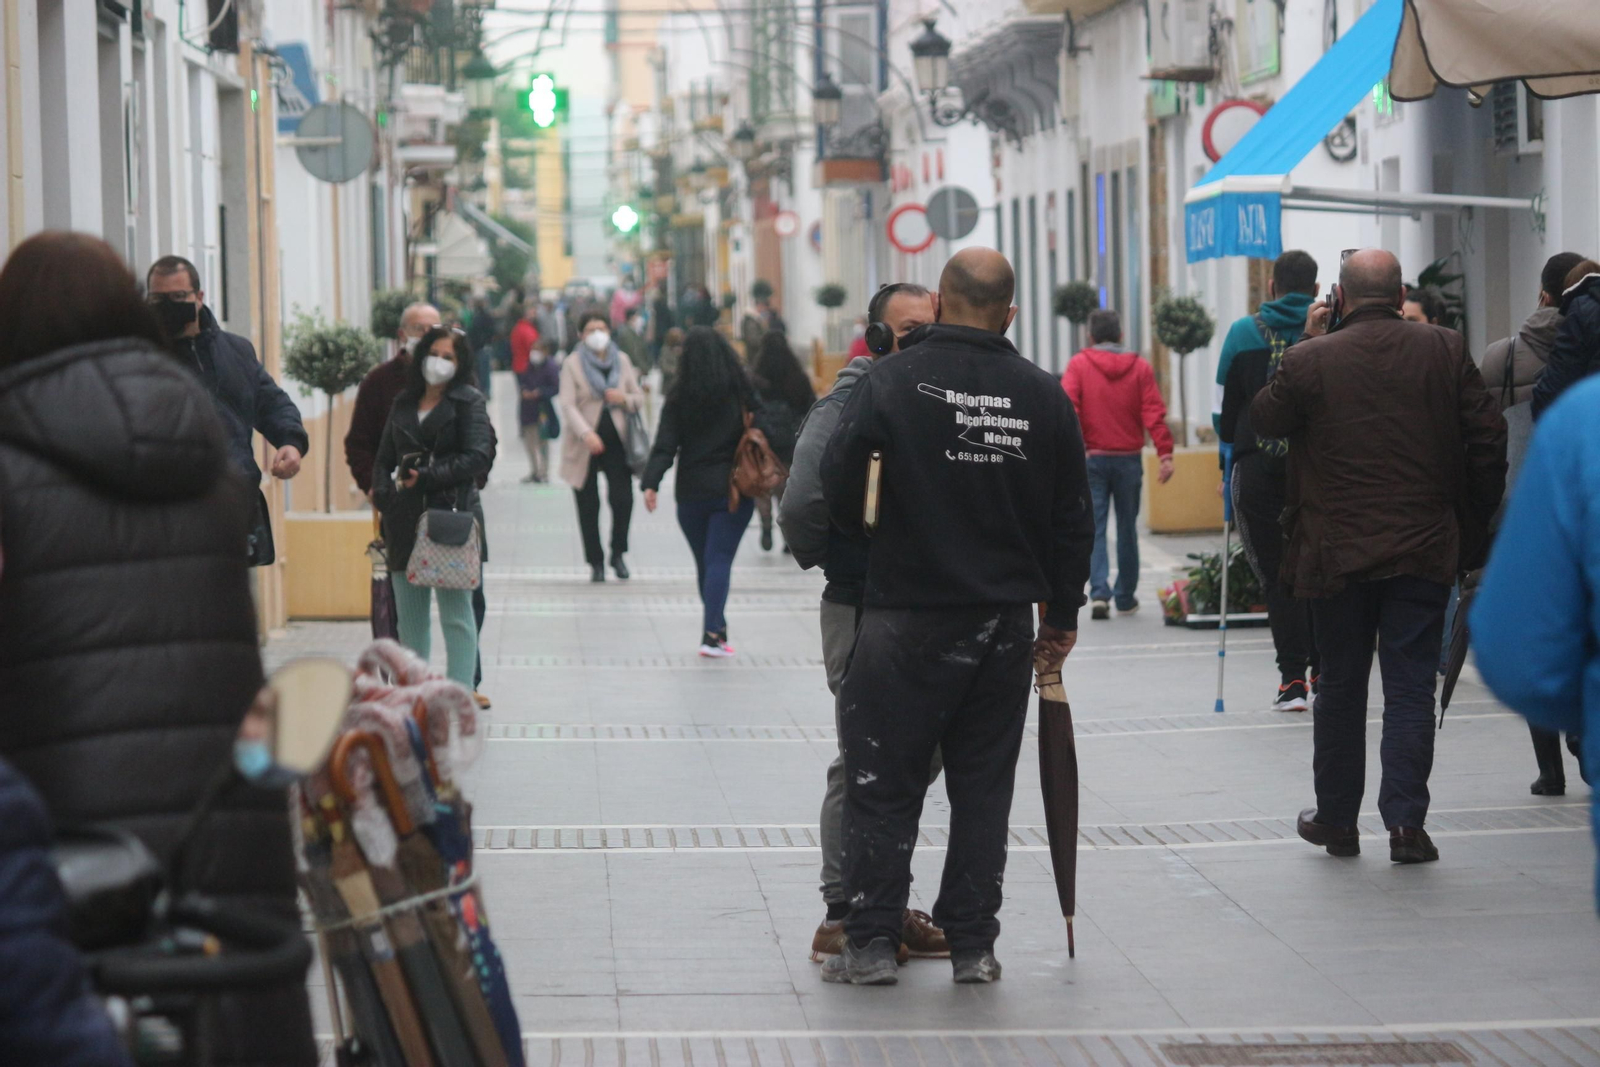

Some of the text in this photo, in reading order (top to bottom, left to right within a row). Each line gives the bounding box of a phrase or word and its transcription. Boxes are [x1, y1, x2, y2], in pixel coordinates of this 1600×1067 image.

[946, 389, 1011, 408] Reformas
[984, 432, 1022, 447] Nene
[973, 453, 989, 463] 824
